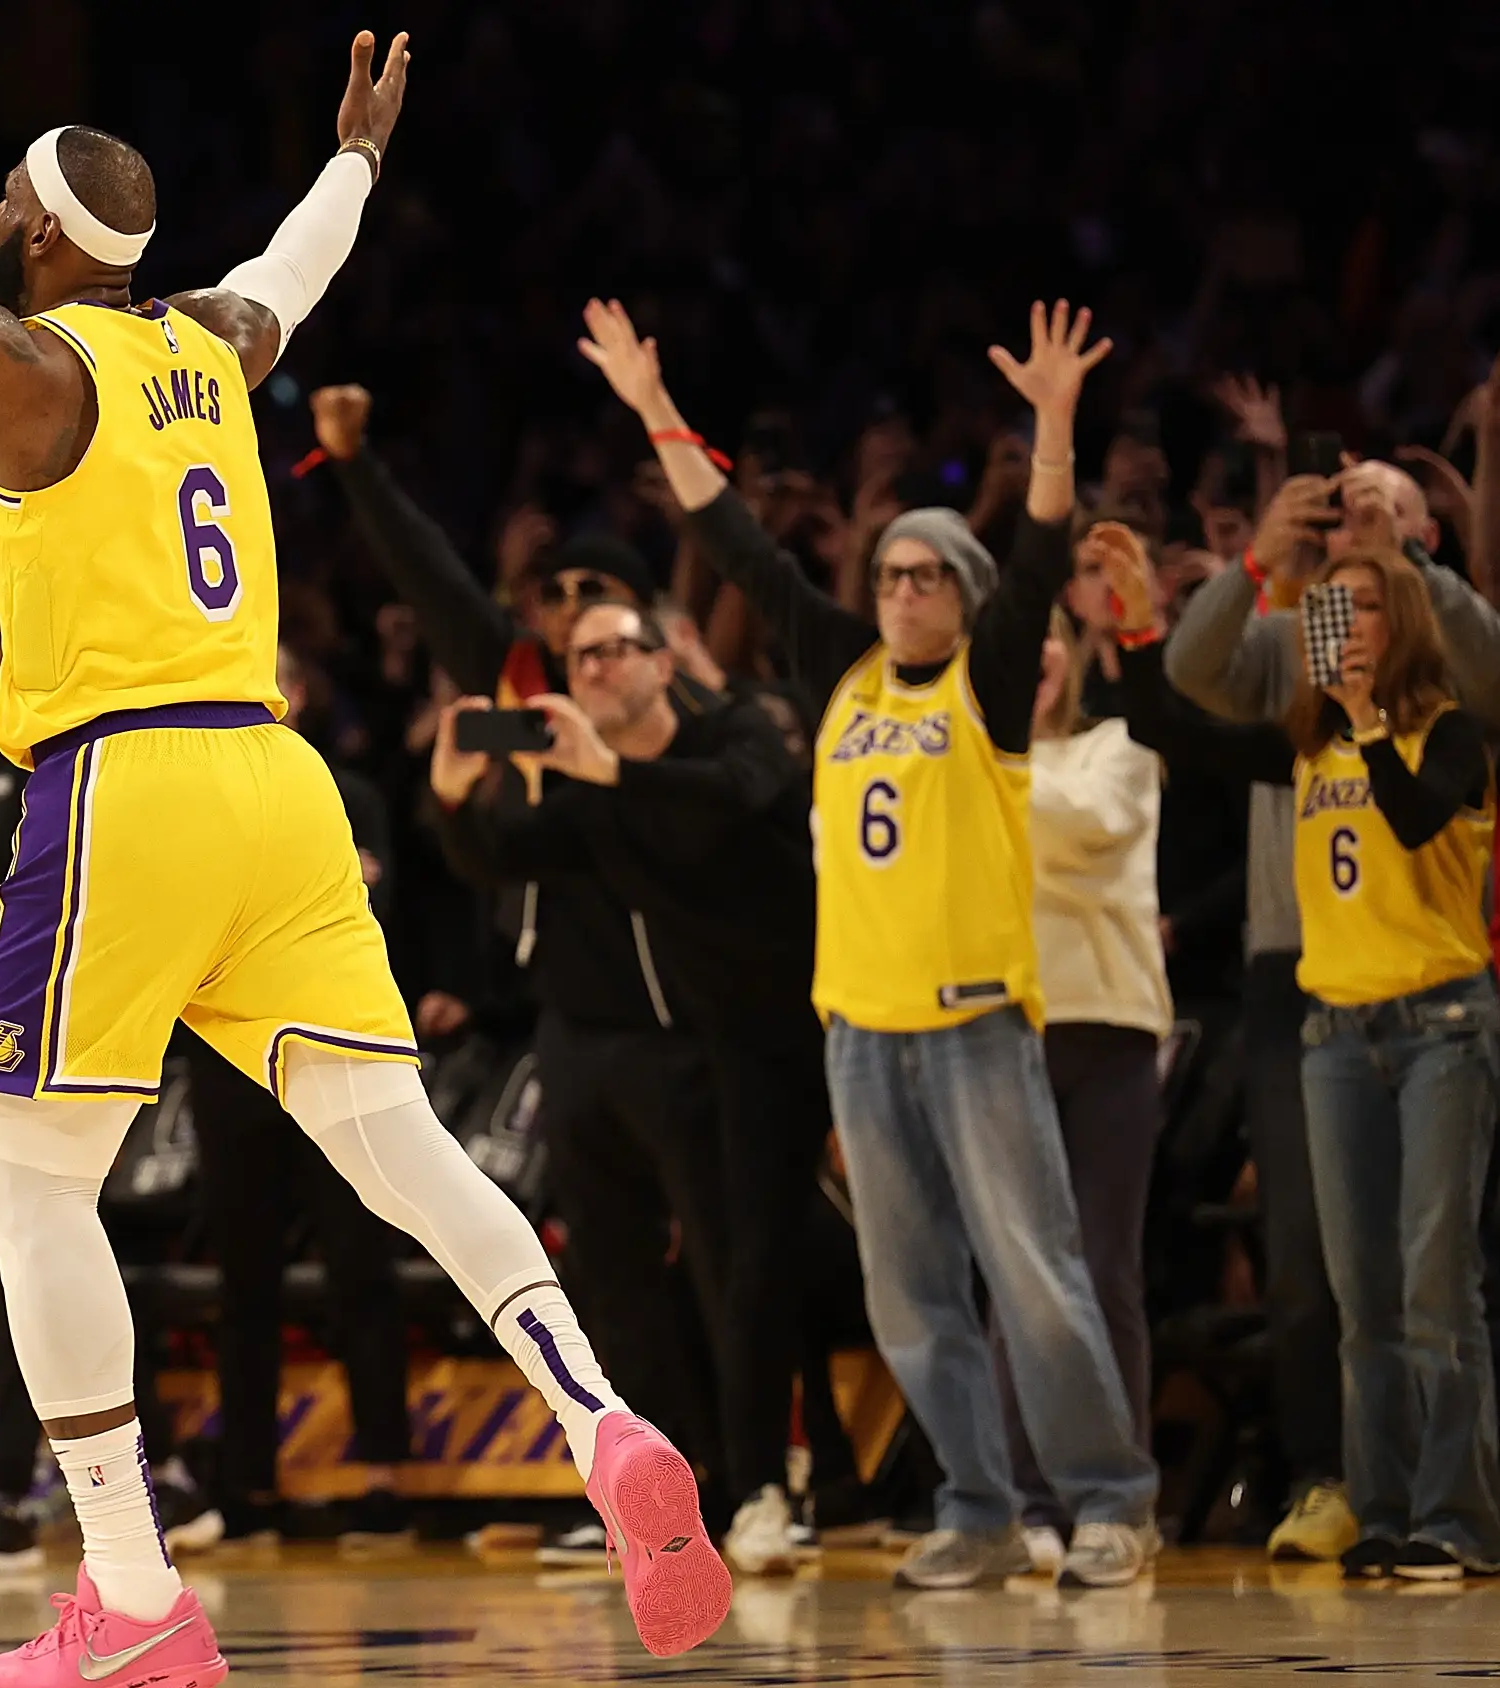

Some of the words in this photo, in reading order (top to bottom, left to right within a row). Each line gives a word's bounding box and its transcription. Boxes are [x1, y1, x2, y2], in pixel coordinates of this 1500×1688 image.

[141, 369, 221, 431] JAMES
[177, 464, 242, 621] 6
[860, 779, 899, 862] 6
[1301, 774, 1371, 819] LAKE
[1330, 827, 1359, 893] 6
